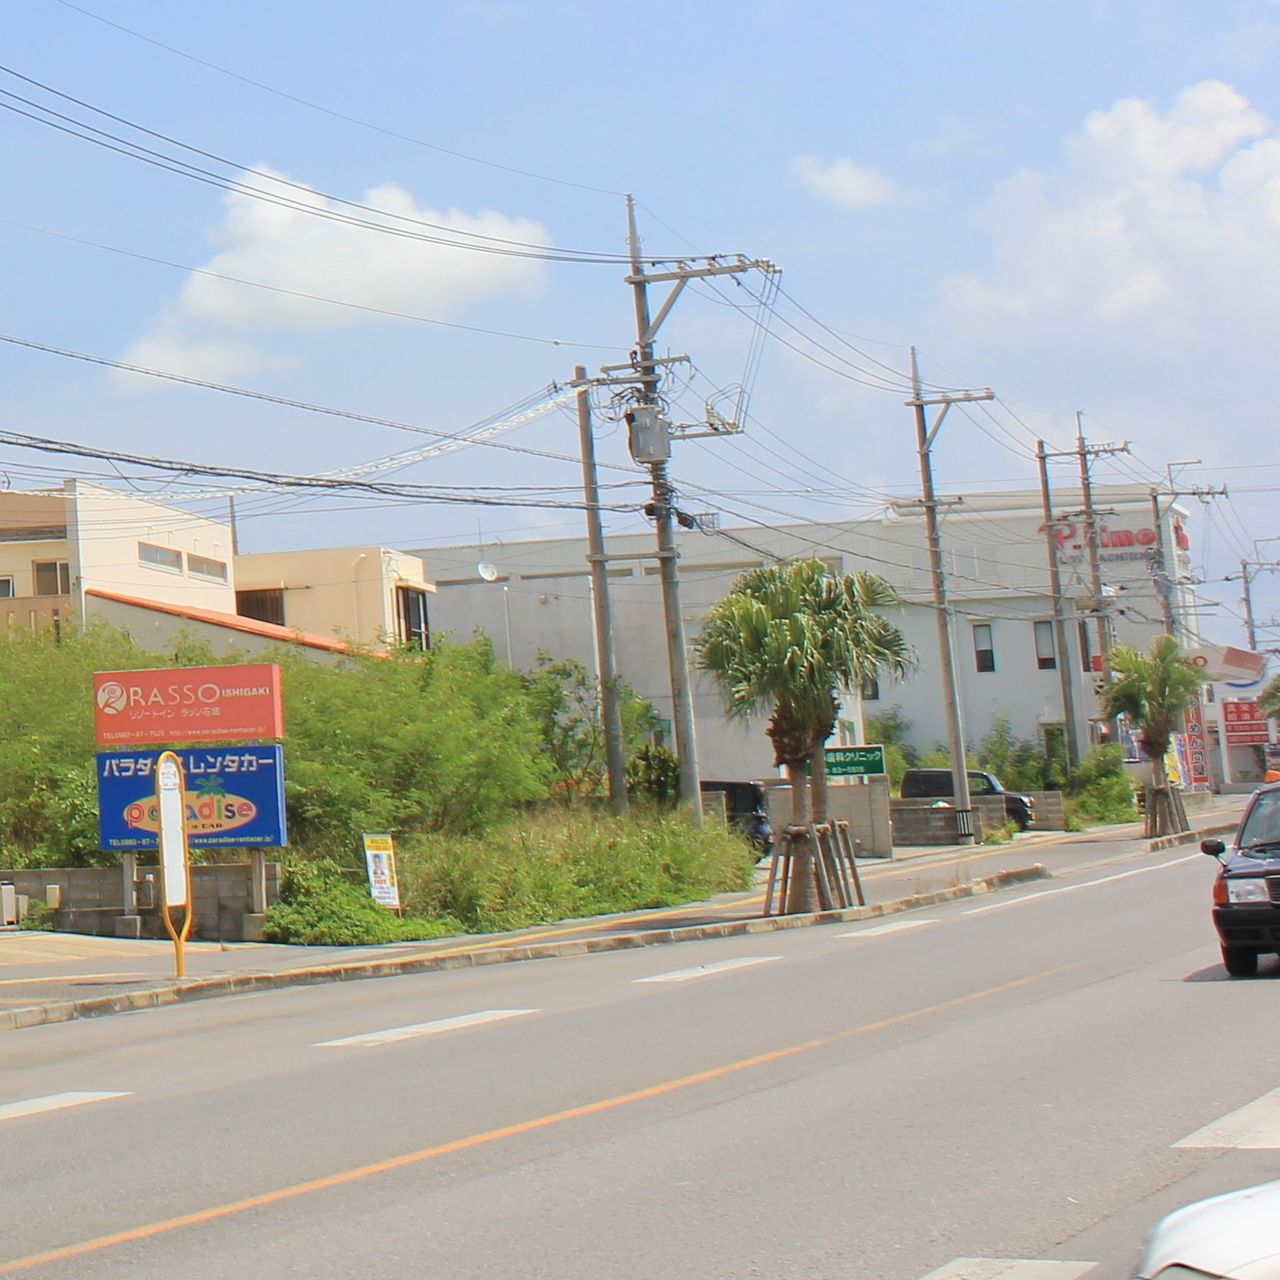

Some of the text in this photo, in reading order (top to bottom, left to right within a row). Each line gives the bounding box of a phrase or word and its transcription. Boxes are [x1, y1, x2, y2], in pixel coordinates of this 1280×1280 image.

[129, 683, 270, 707] RASSO ISHIGAKI
[190, 753, 274, 773] レンタカー
